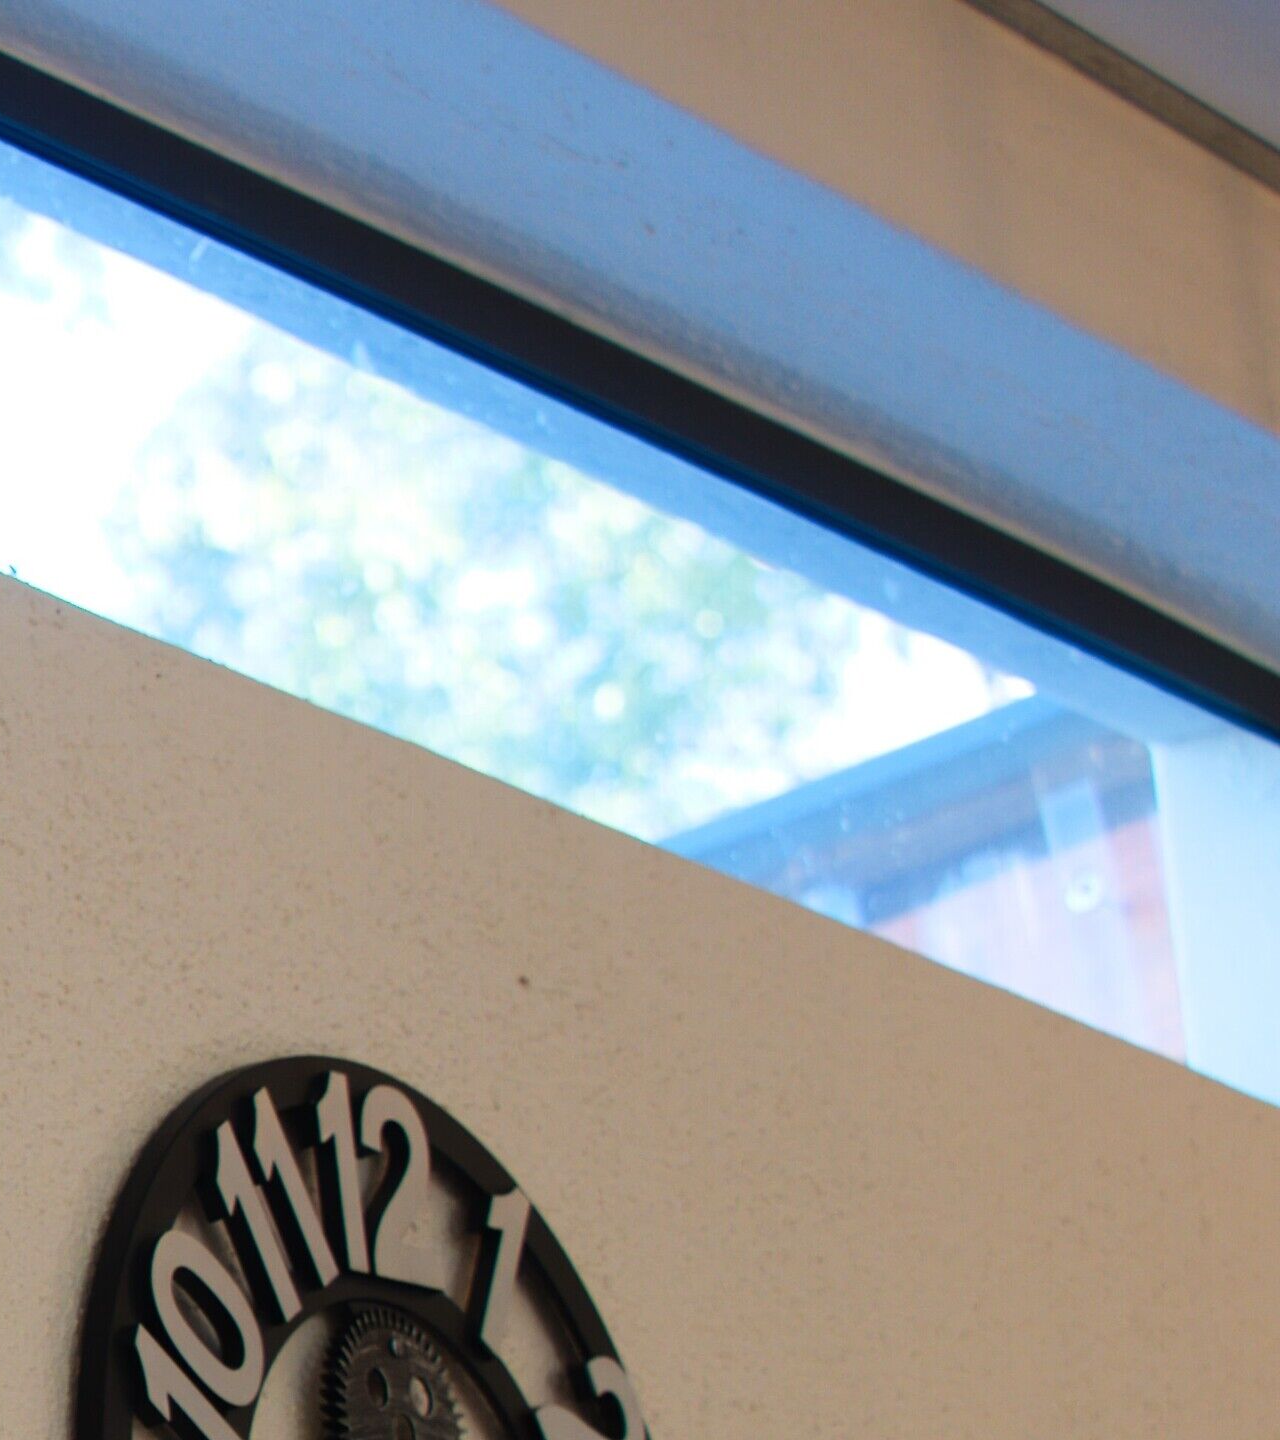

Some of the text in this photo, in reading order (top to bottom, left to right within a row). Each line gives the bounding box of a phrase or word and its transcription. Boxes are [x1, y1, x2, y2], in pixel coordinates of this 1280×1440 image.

[217, 1086, 339, 1322] 11
[317, 1071, 444, 1291] 12
[480, 1188, 529, 1345] 1
